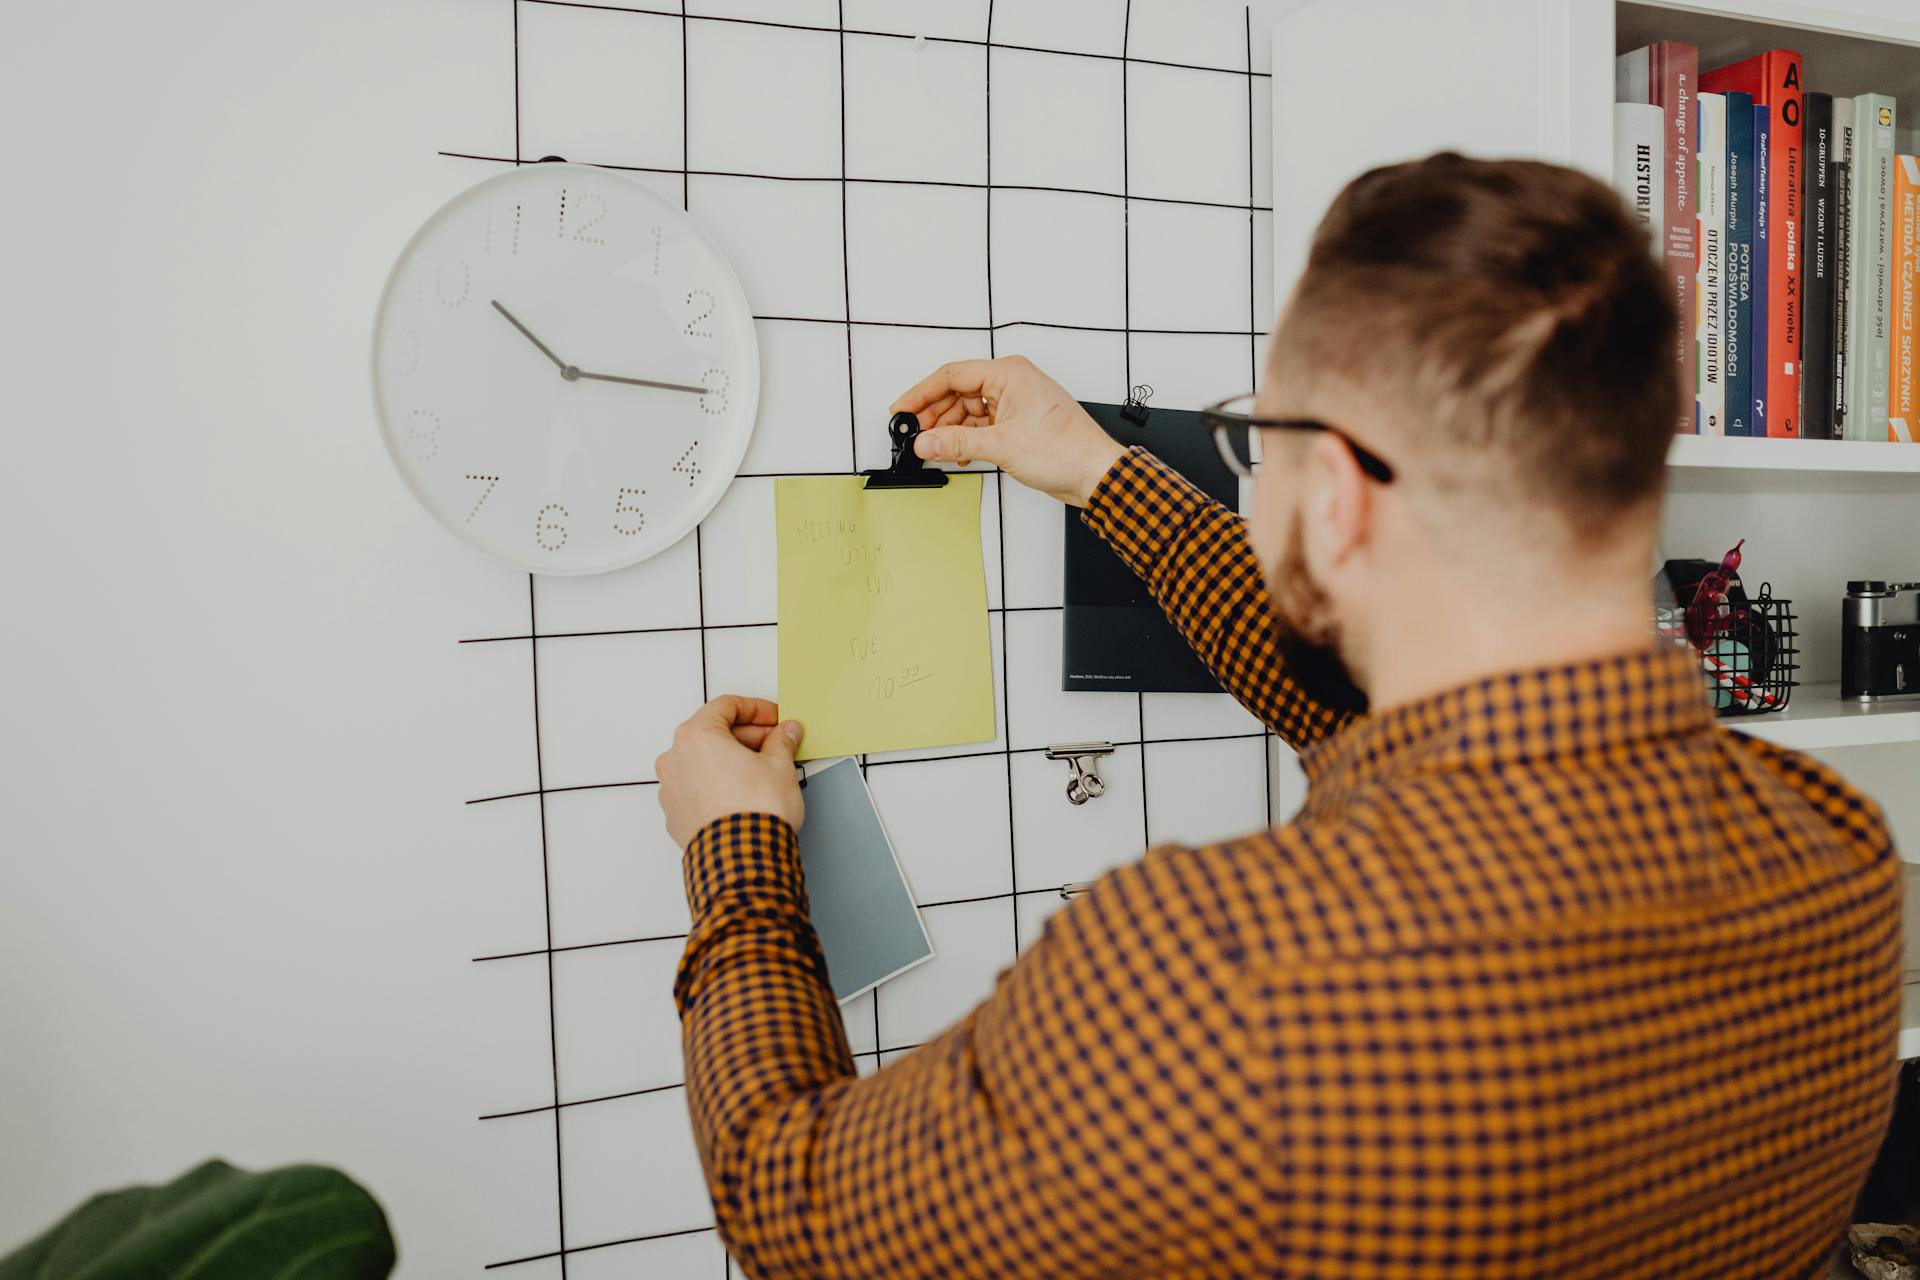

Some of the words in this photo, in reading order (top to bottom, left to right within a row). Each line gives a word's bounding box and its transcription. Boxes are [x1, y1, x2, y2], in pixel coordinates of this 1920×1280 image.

[1680, 74, 1687, 86] a
[1676, 89, 1689, 134] change
[1679, 137, 1689, 153] of
[1818, 128, 1826, 187] 10-GRUPPEN
[1675, 155, 1688, 212] appetite
[1730, 152, 1738, 189] Joseph
[1788, 147, 1797, 216] Literatura
[556, 188, 608, 246] 12
[1729, 192, 1738, 230] Murphy
[1904, 192, 1914, 256] METODA
[651, 225, 663, 276] 1
[1708, 229, 1718, 288] OTOCZENI
[1786, 221, 1796, 271] polska
[1739, 244, 1749, 301] POTĘGA
[1788, 276, 1796, 296] XX
[1902, 261, 1913, 330] CZARNEJ
[683, 288, 716, 338] 2
[1708, 292, 1718, 329] PRZEZ
[1728, 243, 1738, 376] PODŚWIADOMOŚCI
[1787, 301, 1795, 343] wieku
[1708, 333, 1718, 384] IDIOTÓW
[1901, 335, 1912, 412] SKRZYNKI
[700, 368, 731, 415] 3
[672, 439, 703, 489] 4
[465, 473, 500, 524] 7
[613, 488, 647, 536] 5
[536, 504, 569, 552] 6
[849, 638, 879, 661] TUE
